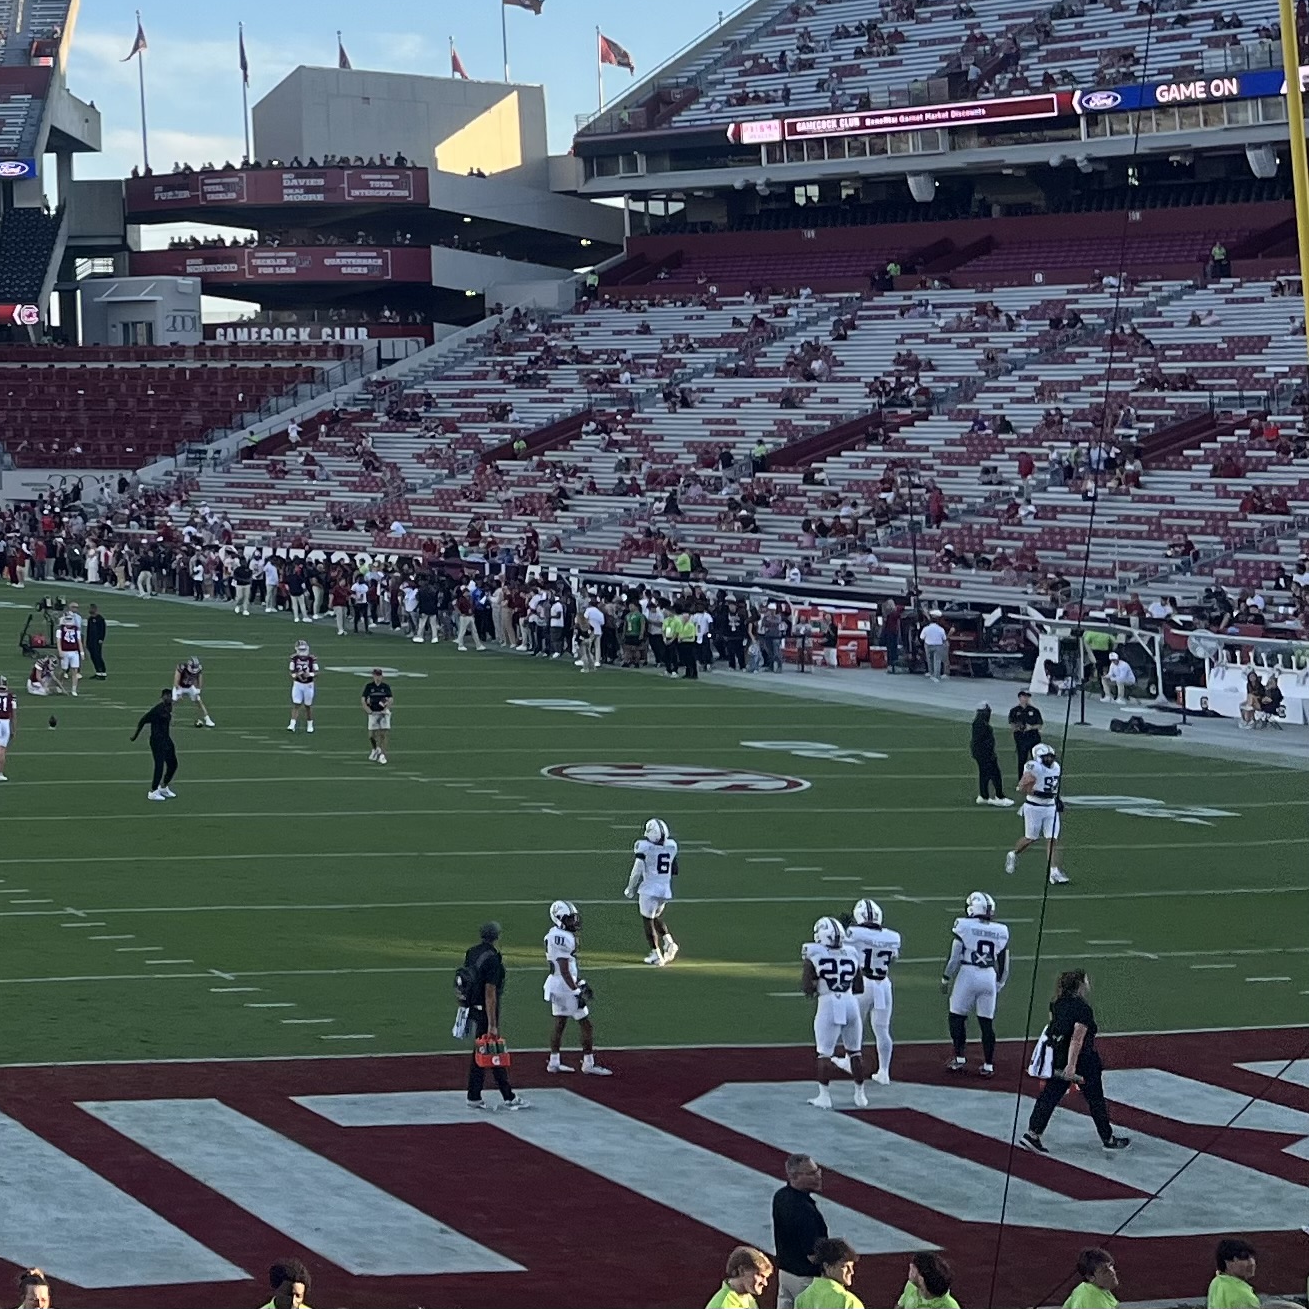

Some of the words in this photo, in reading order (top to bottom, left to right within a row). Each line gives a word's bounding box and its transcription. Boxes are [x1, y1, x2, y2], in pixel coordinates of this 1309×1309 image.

[1155, 80, 1206, 103] GAME
[1210, 77, 1238, 96] ON
[215, 327, 311, 341] GAMECOCK
[321, 327, 369, 341] CLUB
[657, 853, 670, 874] 6
[819, 958, 856, 987] 22
[863, 948, 892, 976] 13
